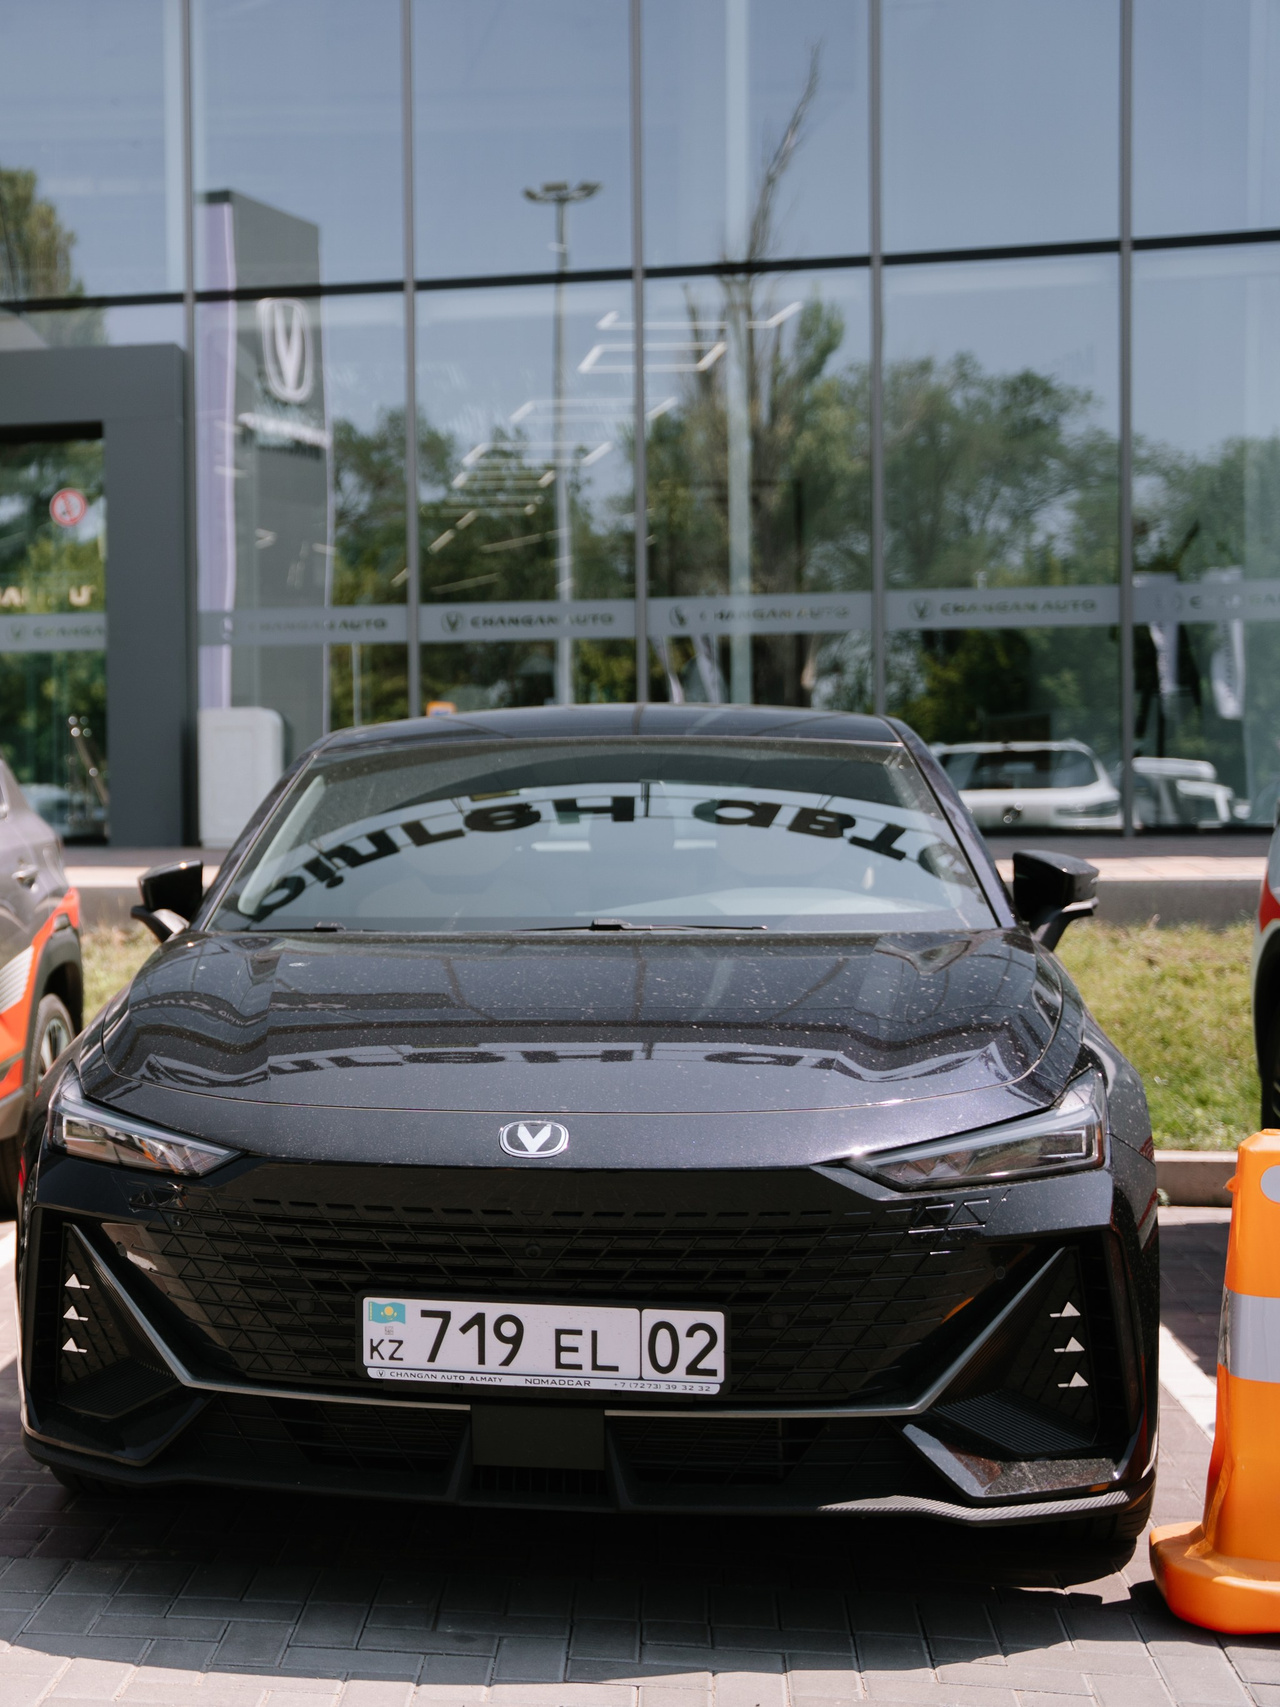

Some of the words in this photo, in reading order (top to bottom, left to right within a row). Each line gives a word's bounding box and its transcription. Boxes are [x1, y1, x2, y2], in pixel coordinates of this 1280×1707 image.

[370, 1338, 404, 1361] KZ
[420, 1309, 525, 1367] 719
[554, 1329, 619, 1372] EL
[647, 1320, 718, 1377] 02
[390, 1371, 438, 1380] CHANGAN
[524, 1378, 591, 1387] NOMADCAR
